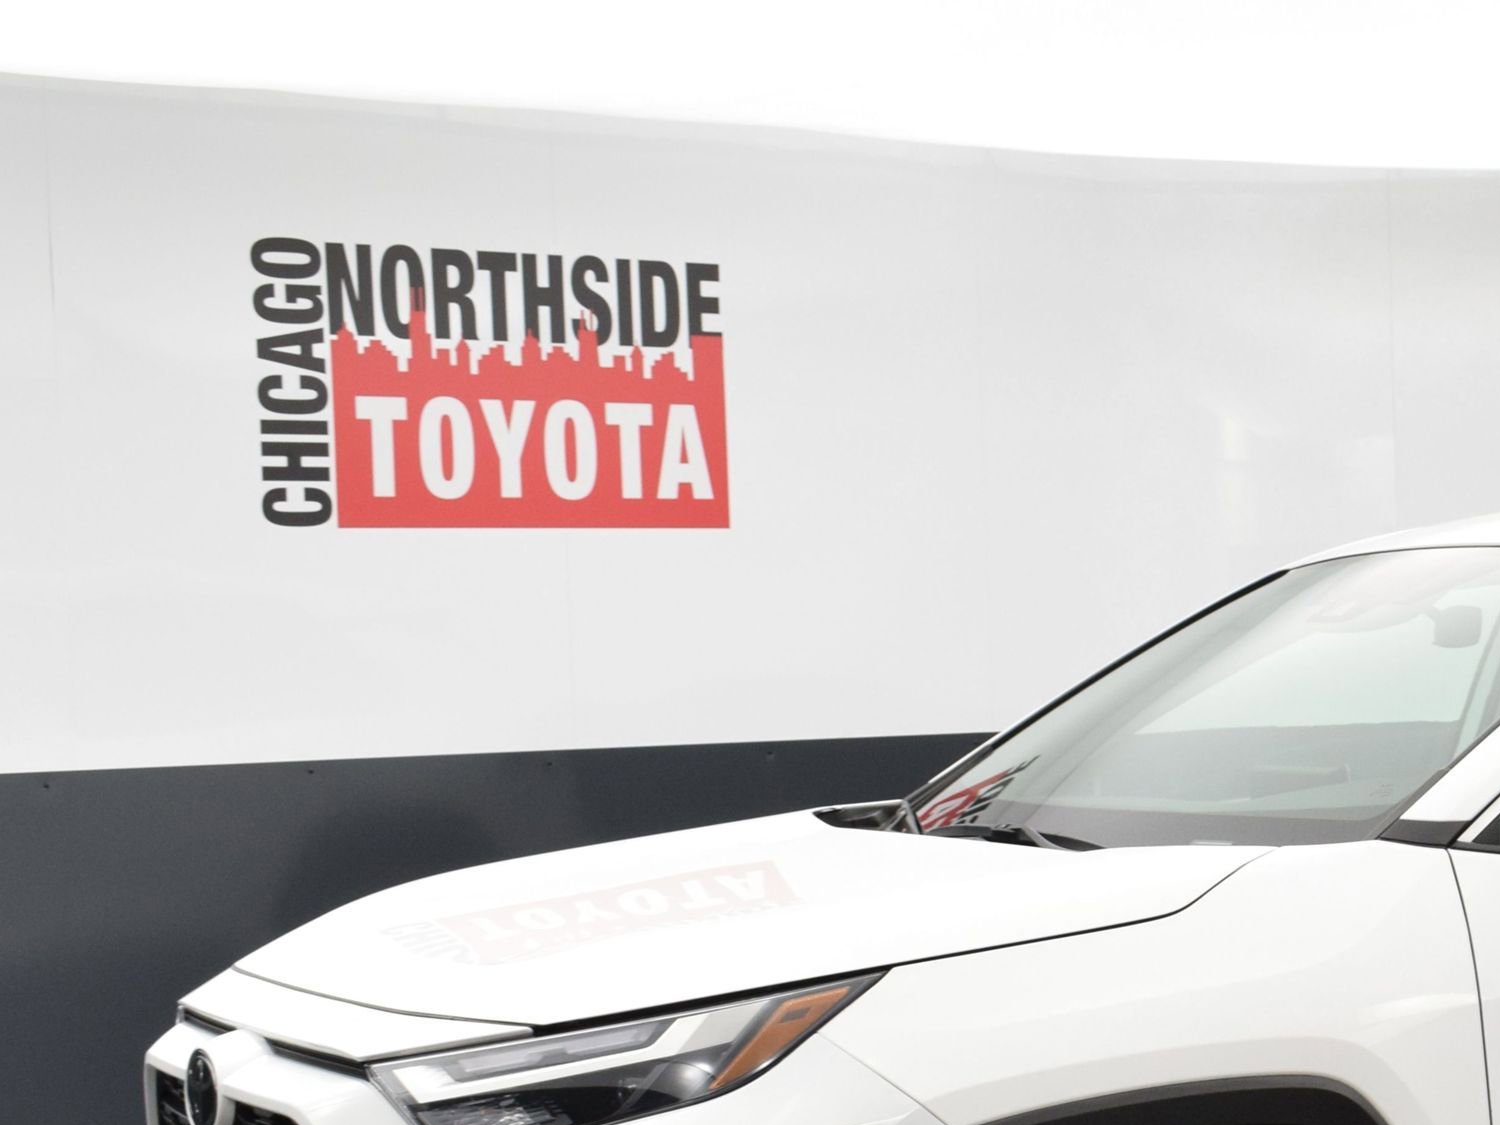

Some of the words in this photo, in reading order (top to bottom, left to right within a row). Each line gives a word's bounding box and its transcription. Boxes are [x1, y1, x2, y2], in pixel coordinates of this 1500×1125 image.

[325, 241, 722, 349] NORTHSIDE
[250, 236, 333, 528] CHICAGO
[354, 394, 715, 501] TOYOTA
